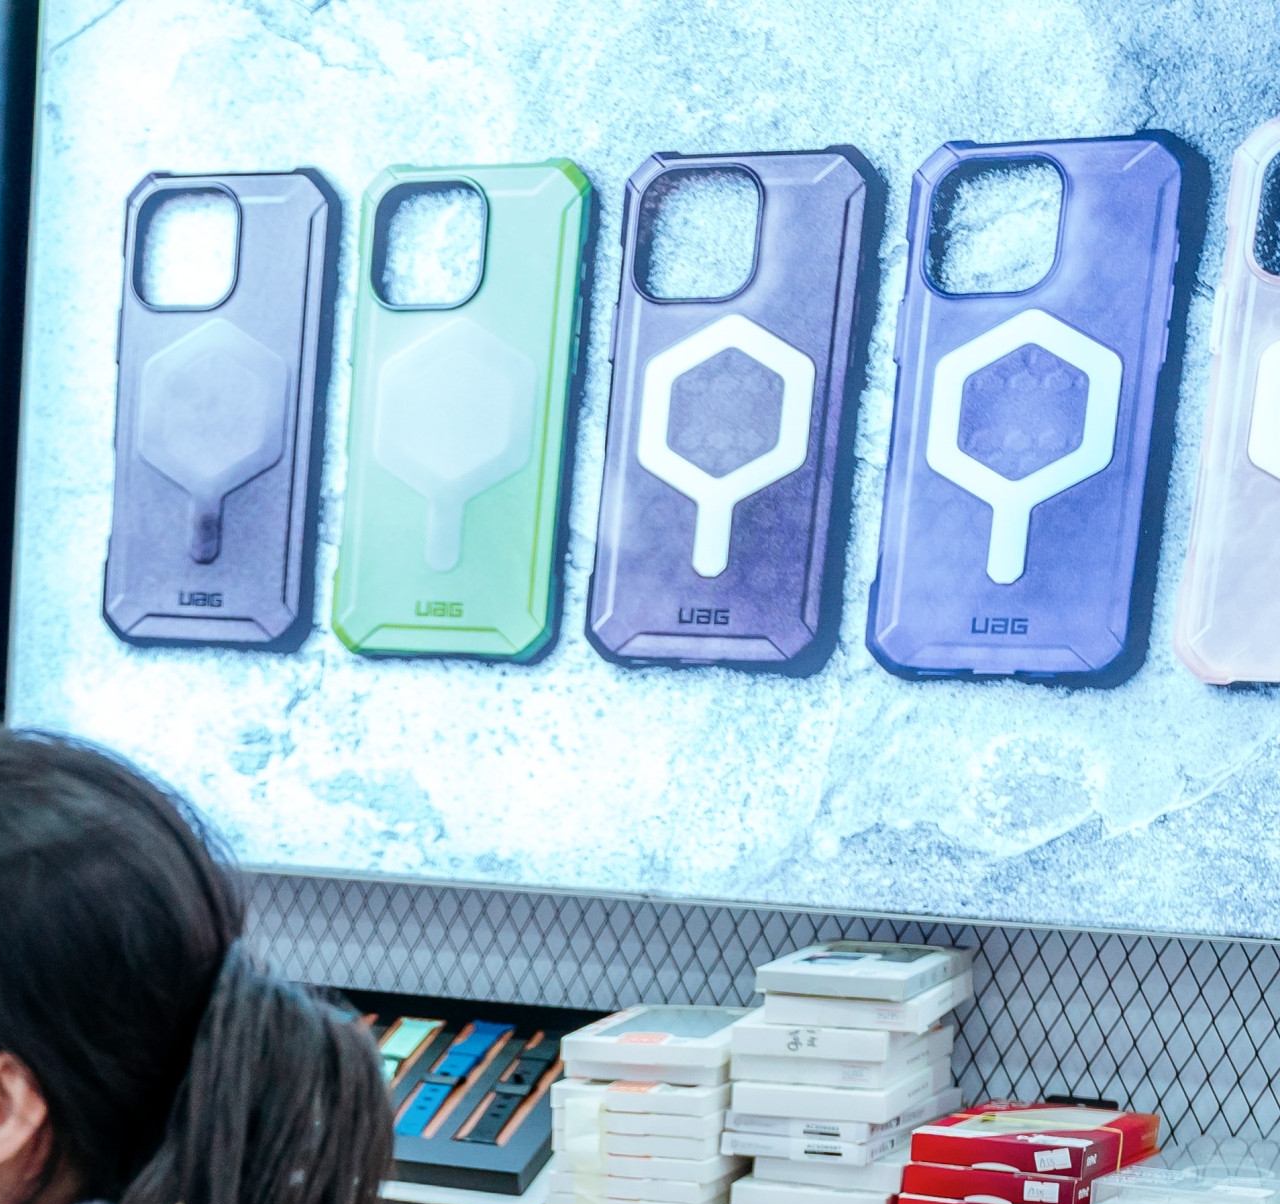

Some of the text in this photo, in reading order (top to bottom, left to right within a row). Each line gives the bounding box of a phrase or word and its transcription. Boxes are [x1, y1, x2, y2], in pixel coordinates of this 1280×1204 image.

[178, 592, 222, 609] UAG
[414, 601, 464, 620] UAG
[677, 608, 731, 626] UAG
[971, 616, 1030, 636] UAG
